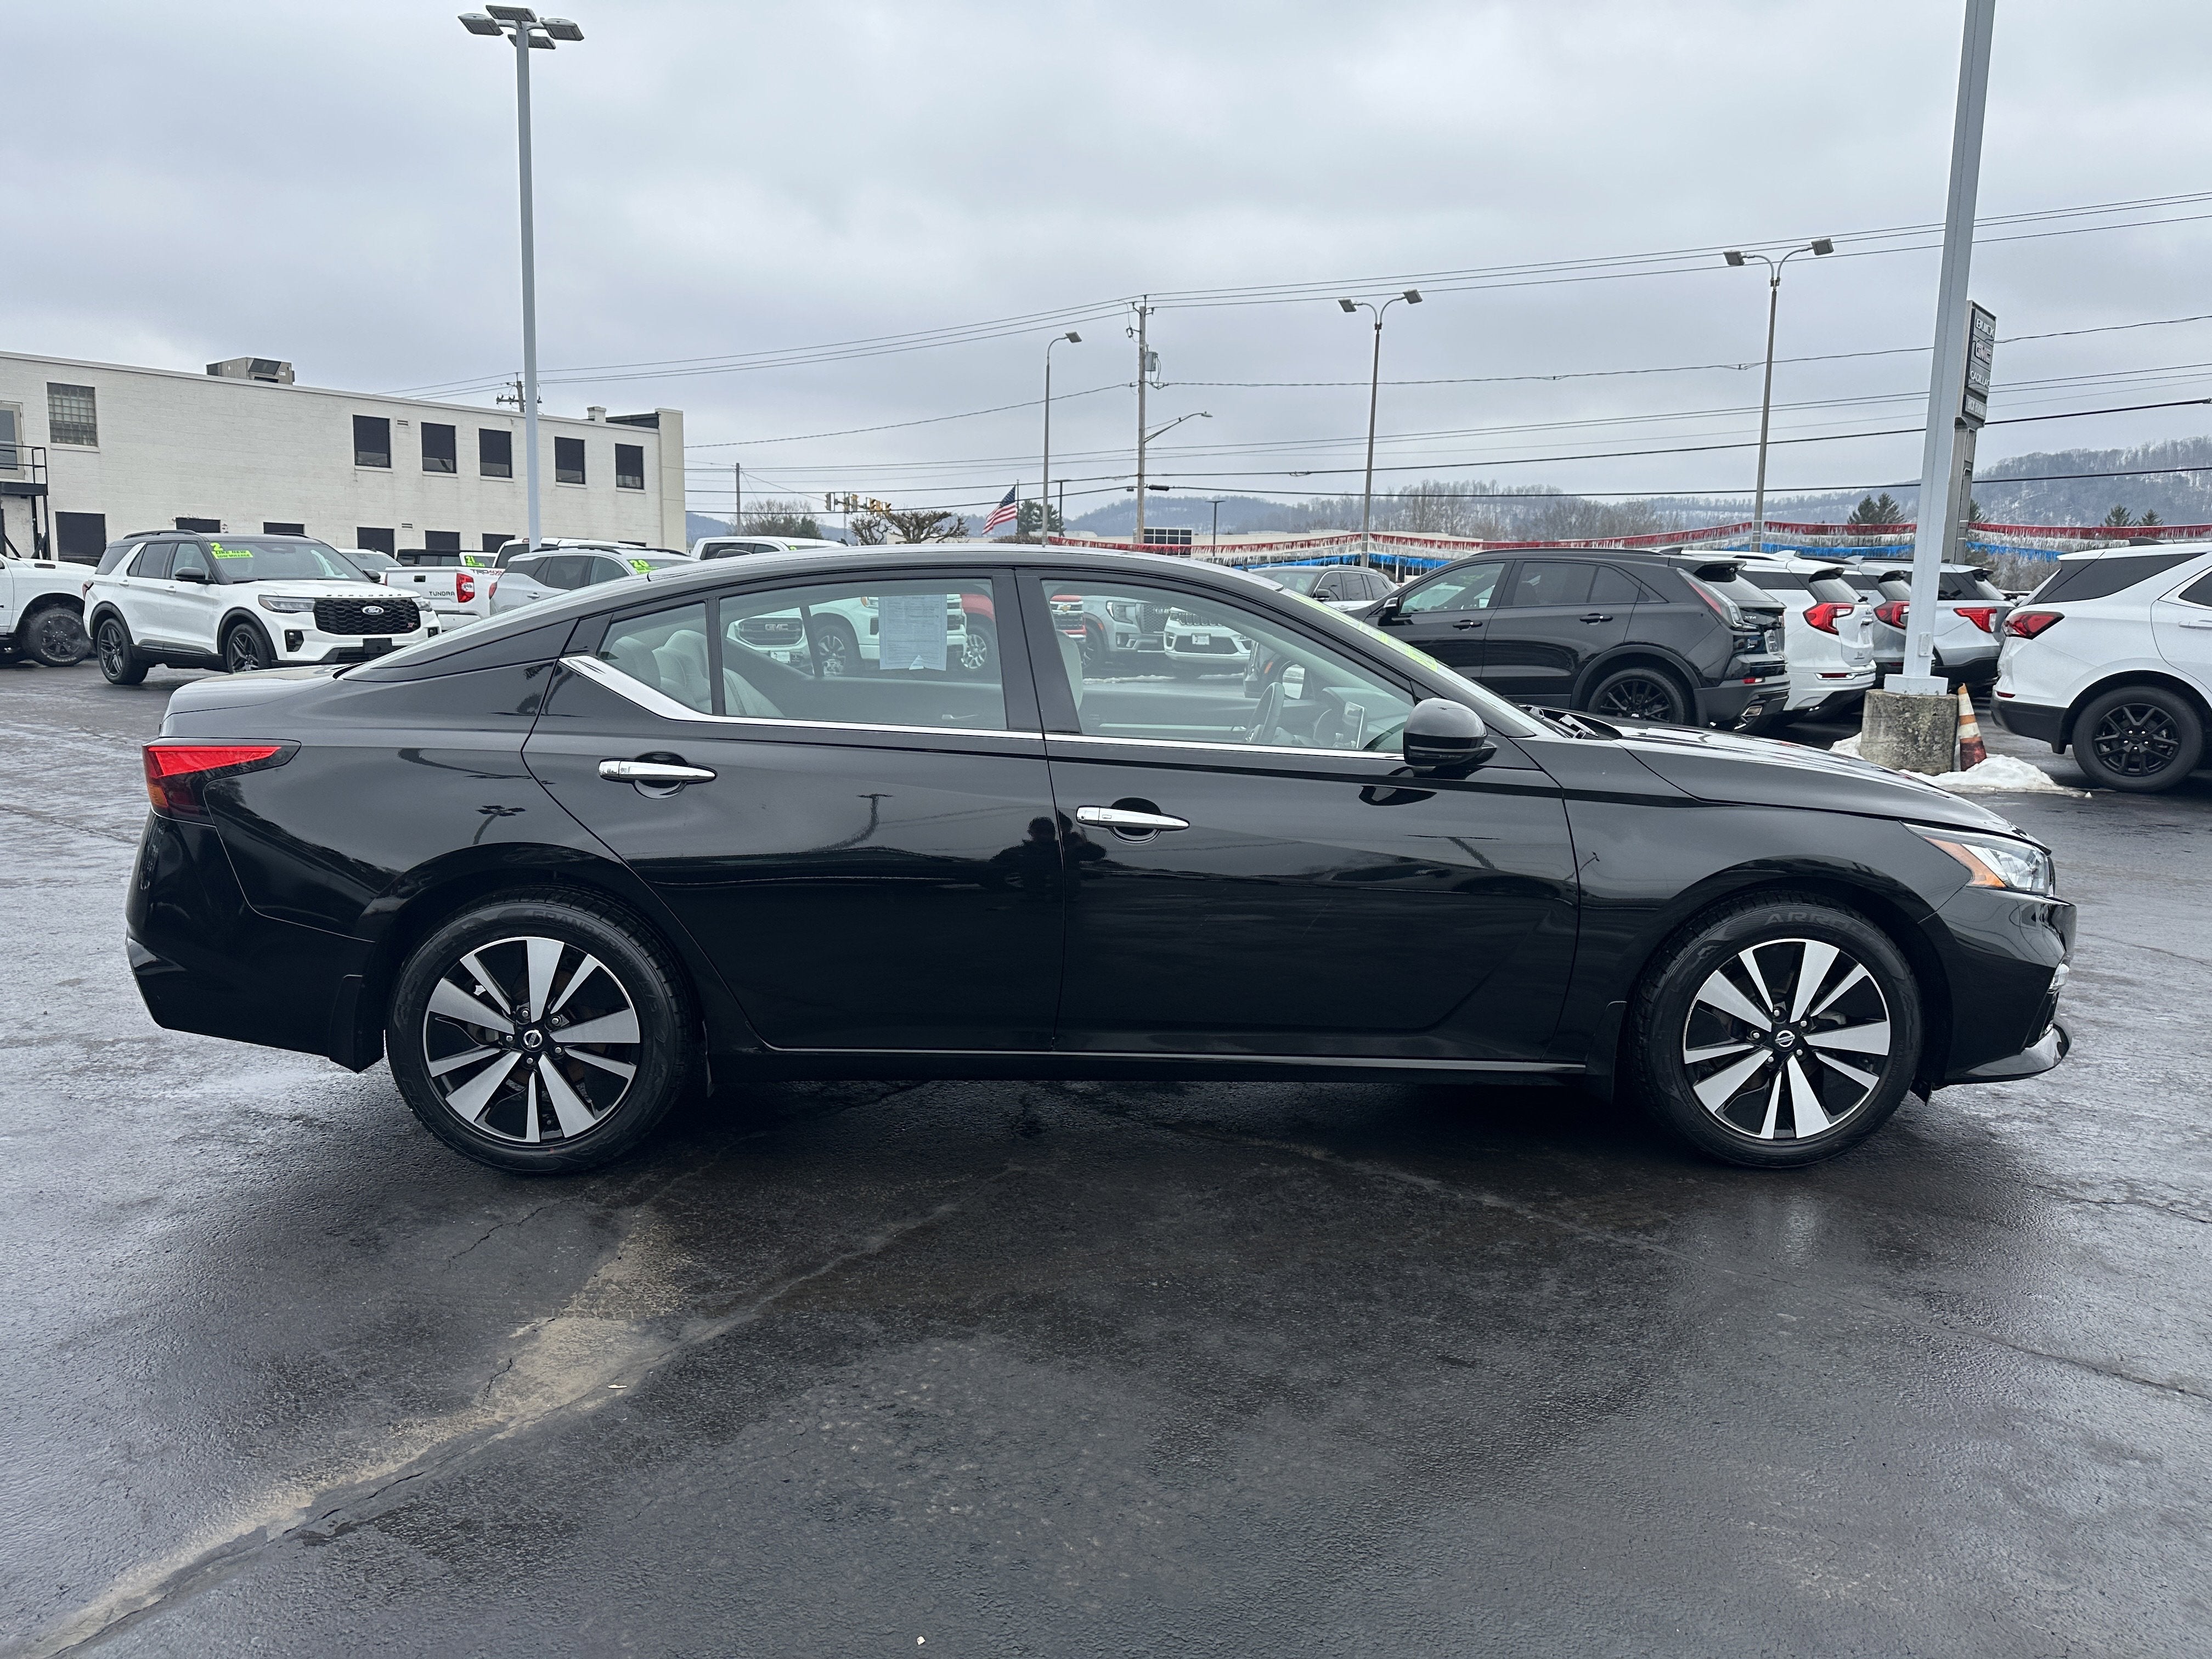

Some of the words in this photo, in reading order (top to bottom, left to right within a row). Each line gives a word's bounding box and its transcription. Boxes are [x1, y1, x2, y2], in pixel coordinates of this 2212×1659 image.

[1976, 319, 1994, 338] BUICK
[1975, 342, 1992, 363] GMC
[629, 559, 650, 567] 20
[765, 623, 788, 631] GMC
[532, 910, 595, 936] GRAND
